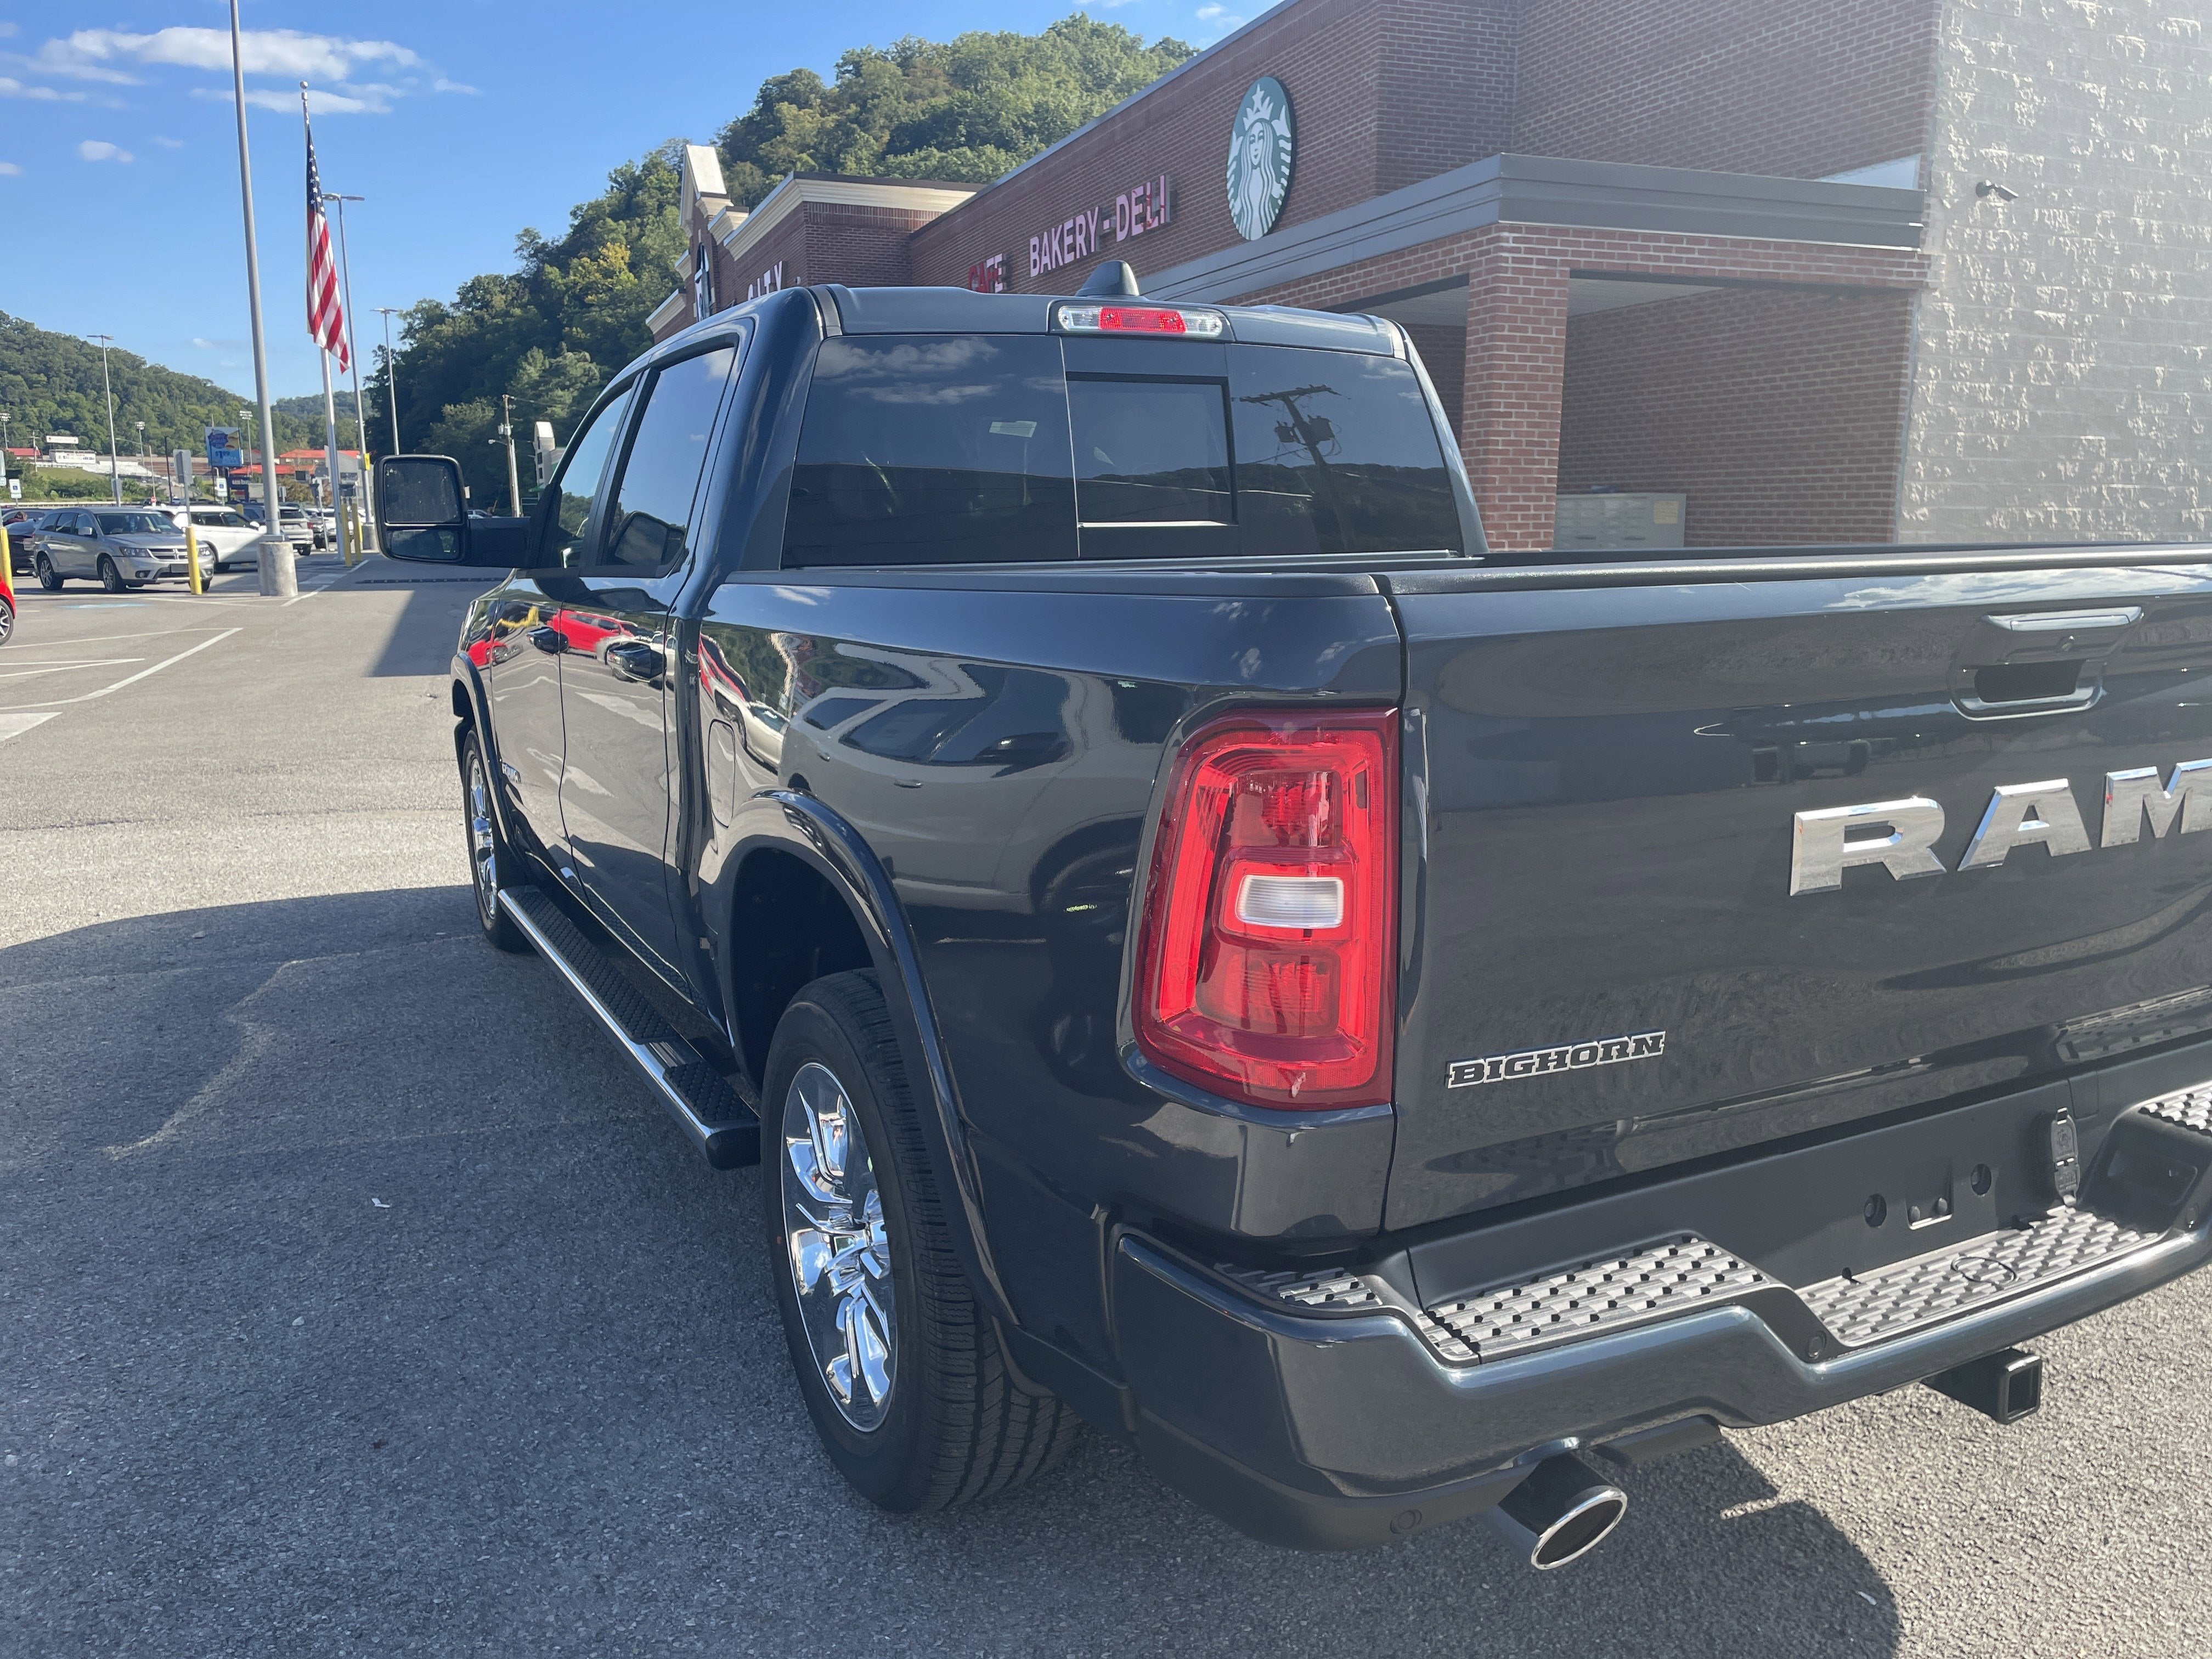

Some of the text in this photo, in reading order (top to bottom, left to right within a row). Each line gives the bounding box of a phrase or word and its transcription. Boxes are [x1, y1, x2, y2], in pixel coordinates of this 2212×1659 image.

[1029, 206, 1099, 278] BAKERY
[1116, 174, 1166, 242] DELI
[1790, 758, 2212, 896] RAM
[1447, 1031, 1666, 1089] BIGHORN
